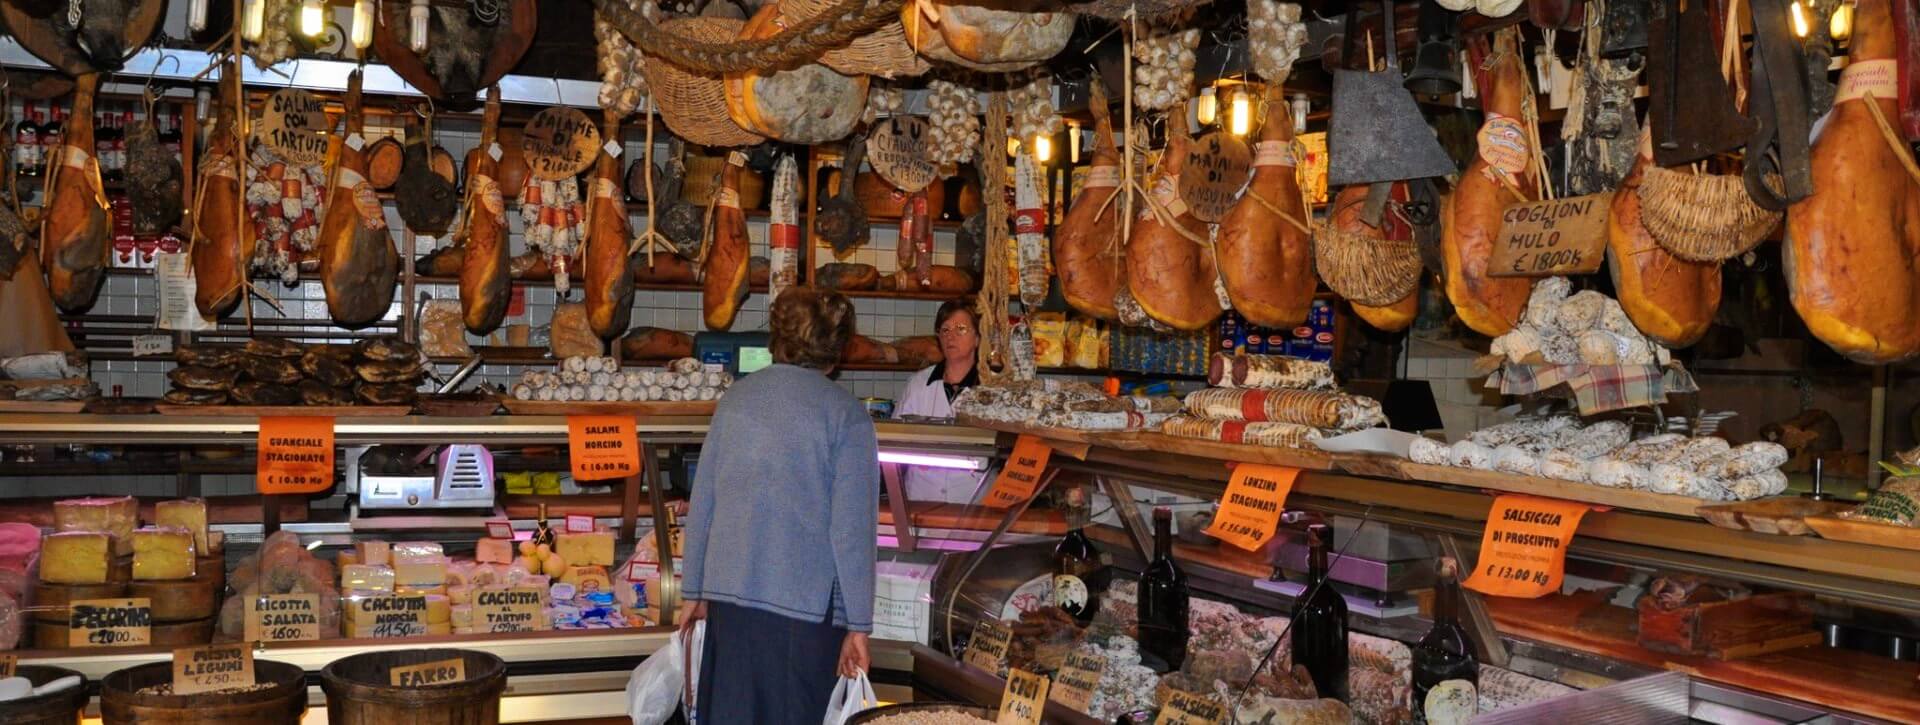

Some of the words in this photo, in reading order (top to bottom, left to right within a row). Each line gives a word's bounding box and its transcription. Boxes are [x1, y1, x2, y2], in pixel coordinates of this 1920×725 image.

[273, 93, 322, 112] SALAME
[284, 113, 308, 128] CON
[535, 112, 594, 138] SALAME
[271, 128, 328, 154] TARTUFO
[1208, 170, 1221, 183] DI
[1503, 199, 1593, 222] COGLIONI
[1543, 219, 1555, 229] DI
[1509, 231, 1560, 249] MULO
[585, 426, 620, 435] SALAME
[270, 437, 323, 448] GUANCIALE
[585, 440, 622, 449] NORCINO
[266, 452, 325, 463] STAGIONATO
[1243, 475, 1278, 492] LONZINO
[1229, 493, 1278, 513] STAGIONATO
[1503, 508, 1562, 527] SALSICCIA
[1493, 530, 1502, 543] DI
[1505, 531, 1560, 549] PROSCIUTTO
[1486, 564, 1495, 576] €
[255, 596, 311, 611] RICOTTA
[361, 594, 427, 612] CACIOTTA
[478, 588, 539, 606] CACIOTTA
[71, 602, 151, 628] PECORINO
[263, 613, 317, 626] SALATA
[376, 611, 418, 624] NORCIA
[486, 613, 532, 622] TARTUFO
[193, 646, 242, 662] MISTO
[184, 661, 243, 676] LEGUMI
[399, 666, 457, 688] FARRO
